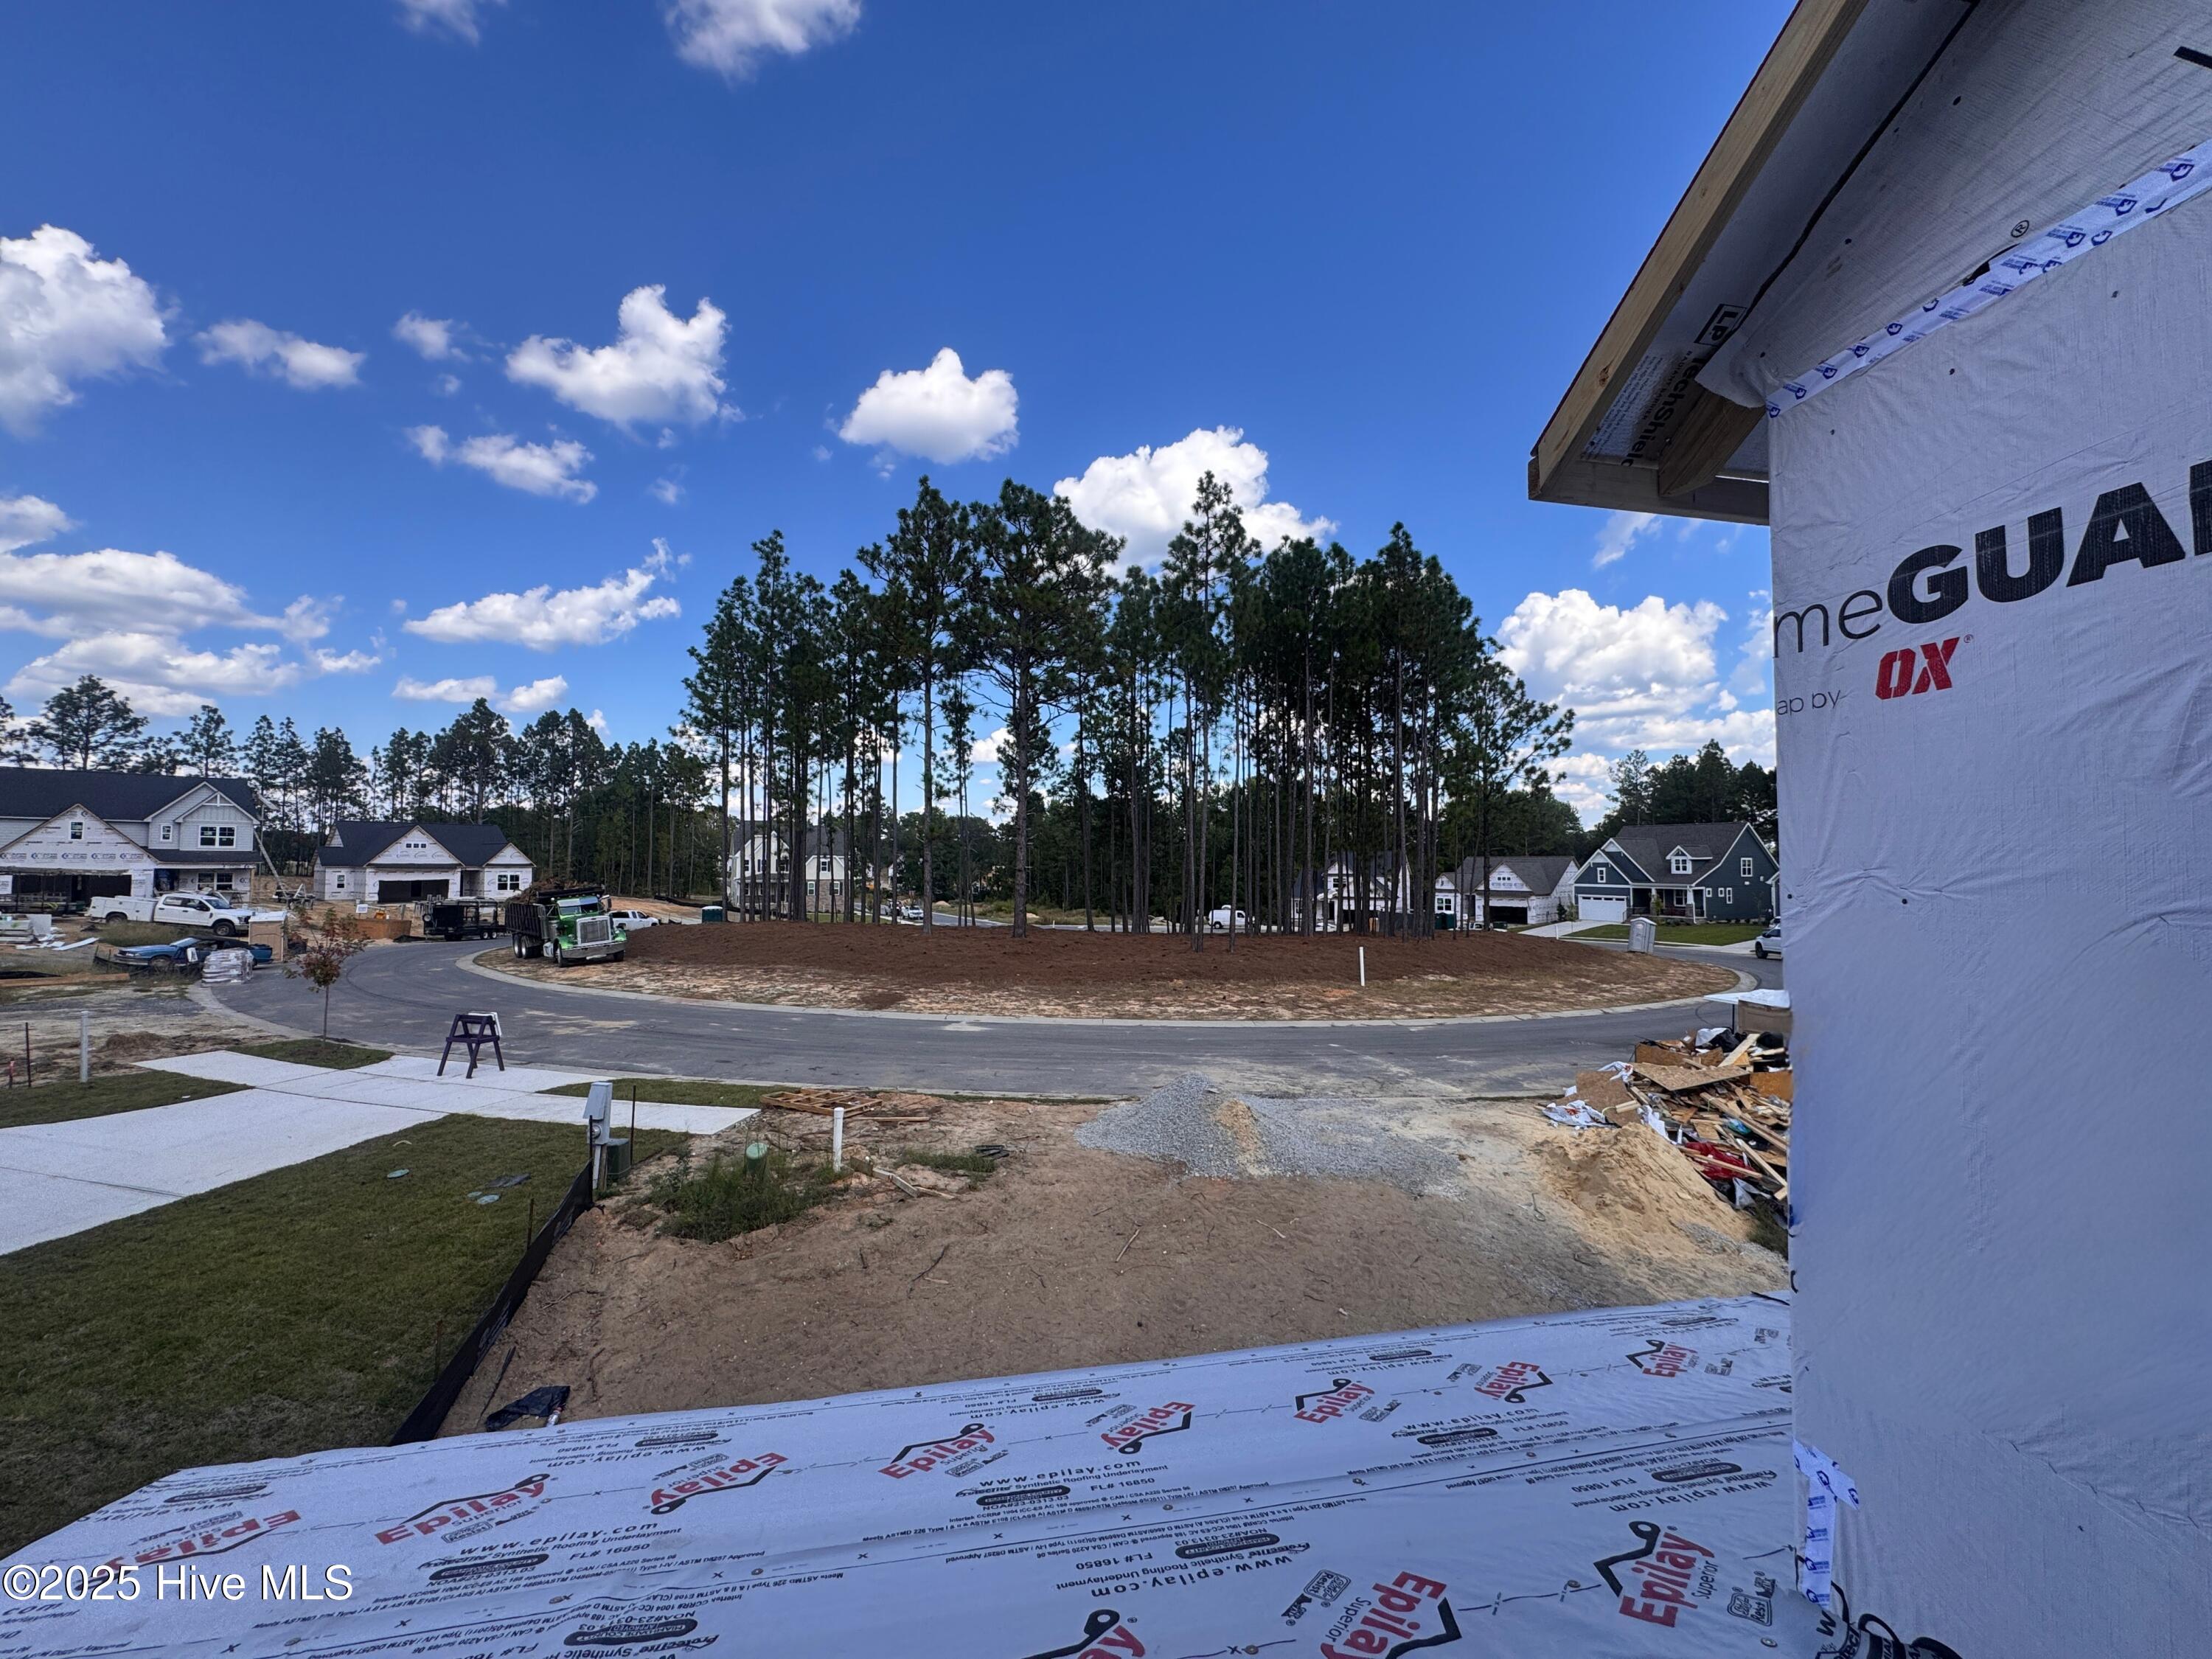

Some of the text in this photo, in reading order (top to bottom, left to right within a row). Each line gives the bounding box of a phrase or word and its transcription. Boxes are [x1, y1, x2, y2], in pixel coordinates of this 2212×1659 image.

[1811, 688, 1843, 710] by
[1642, 1343, 1698, 1377] Epilay
[1474, 1361, 1540, 1399] Epilay
[970, 1399, 1105, 1419] www.epilay.com
[1293, 1381, 1375, 1424] Epilay
[1101, 1401, 1196, 1448] Epilay
[1403, 1408, 1540, 1430] www.epilay.com
[547, 1445, 706, 1468] www.epilay.com
[877, 1429, 995, 1479] Epilay
[939, 1443, 987, 1466] Superior
[651, 1452, 789, 1506] Epilay
[667, 1465, 726, 1488] Superior
[979, 1459, 1141, 1487] www.epilay.com
[1015, 1464, 1169, 1490] Synthetic Roofing Underlayment
[1090, 1477, 1155, 1492] FL# 16850
[1570, 1477, 1719, 1509] Synthetic Roofing Underlayment
[982, 1495, 1069, 1511] NOA#23-0313.03
[1608, 1481, 1773, 1512] www.epilay.com
[374, 1481, 545, 1545] Epilay
[451, 1500, 524, 1527] Superior
[949, 1514, 975, 1523] Intertek
[1248, 1512, 1269, 1520] ASTM
[885, 1530, 912, 1539] ASTMD
[1175, 1521, 1194, 1530] ASTM
[460, 1523, 658, 1556] www.epilay.com
[493, 1527, 682, 1559] Synthetic Roofing Underlayment
[1048, 1541, 1066, 1549] Type
[1091, 1543, 1107, 1551] CSA
[1113, 1540, 1130, 1548] CAN
[1141, 1532, 1173, 1544] approved
[1174, 1527, 1268, 1547] NOA#23-0313.03
[569, 1542, 650, 1561] FL# 16850
[945, 1552, 983, 1564] Approved
[1007, 1547, 1029, 1555] ASTM
[1048, 1548, 1071, 1556] Series
[1071, 1545, 1090, 1554] A220
[1075, 1551, 1153, 1571] FL# 16850
[372, 1593, 407, 1604] Intertek
[524, 1570, 566, 1582] approved
[576, 1565, 594, 1573] CAN
[601, 1561, 619, 1570] CSA
[641, 1556, 665, 1564] Series
[486, 1585, 514, 1595] ASTM
[678, 1557, 703, 1568] ASTM
[727, 1550, 765, 1562] Approved
[1055, 1553, 1245, 1590] Synthetic Roofing Underlayment
[1091, 1555, 1293, 1597] www.epilay.com
[1619, 1531, 1715, 1627] Epilay
[1691, 1559, 1719, 1599] Superior
[751, 1580, 772, 1589] Type
[772, 1579, 787, 1587] 226
[1308, 1571, 1335, 1594] Resist
[697, 1588, 722, 1599] ASTM
[711, 1593, 743, 1603] Intertek
[600, 1602, 627, 1612] ASTM
[655, 1604, 676, 1612] 1004
[676, 1599, 709, 1610] CCRR#
[1328, 1596, 1373, 1644] Superior
[441, 1630, 463, 1639] Type
[458, 1635, 487, 1646] A220
[486, 1632, 506, 1642] CSA
[512, 1627, 533, 1638] CAN
[387, 1637, 416, 1649] ASTM
[499, 1642, 540, 1657] FL#
[563, 1647, 633, 1659] Synthetic
